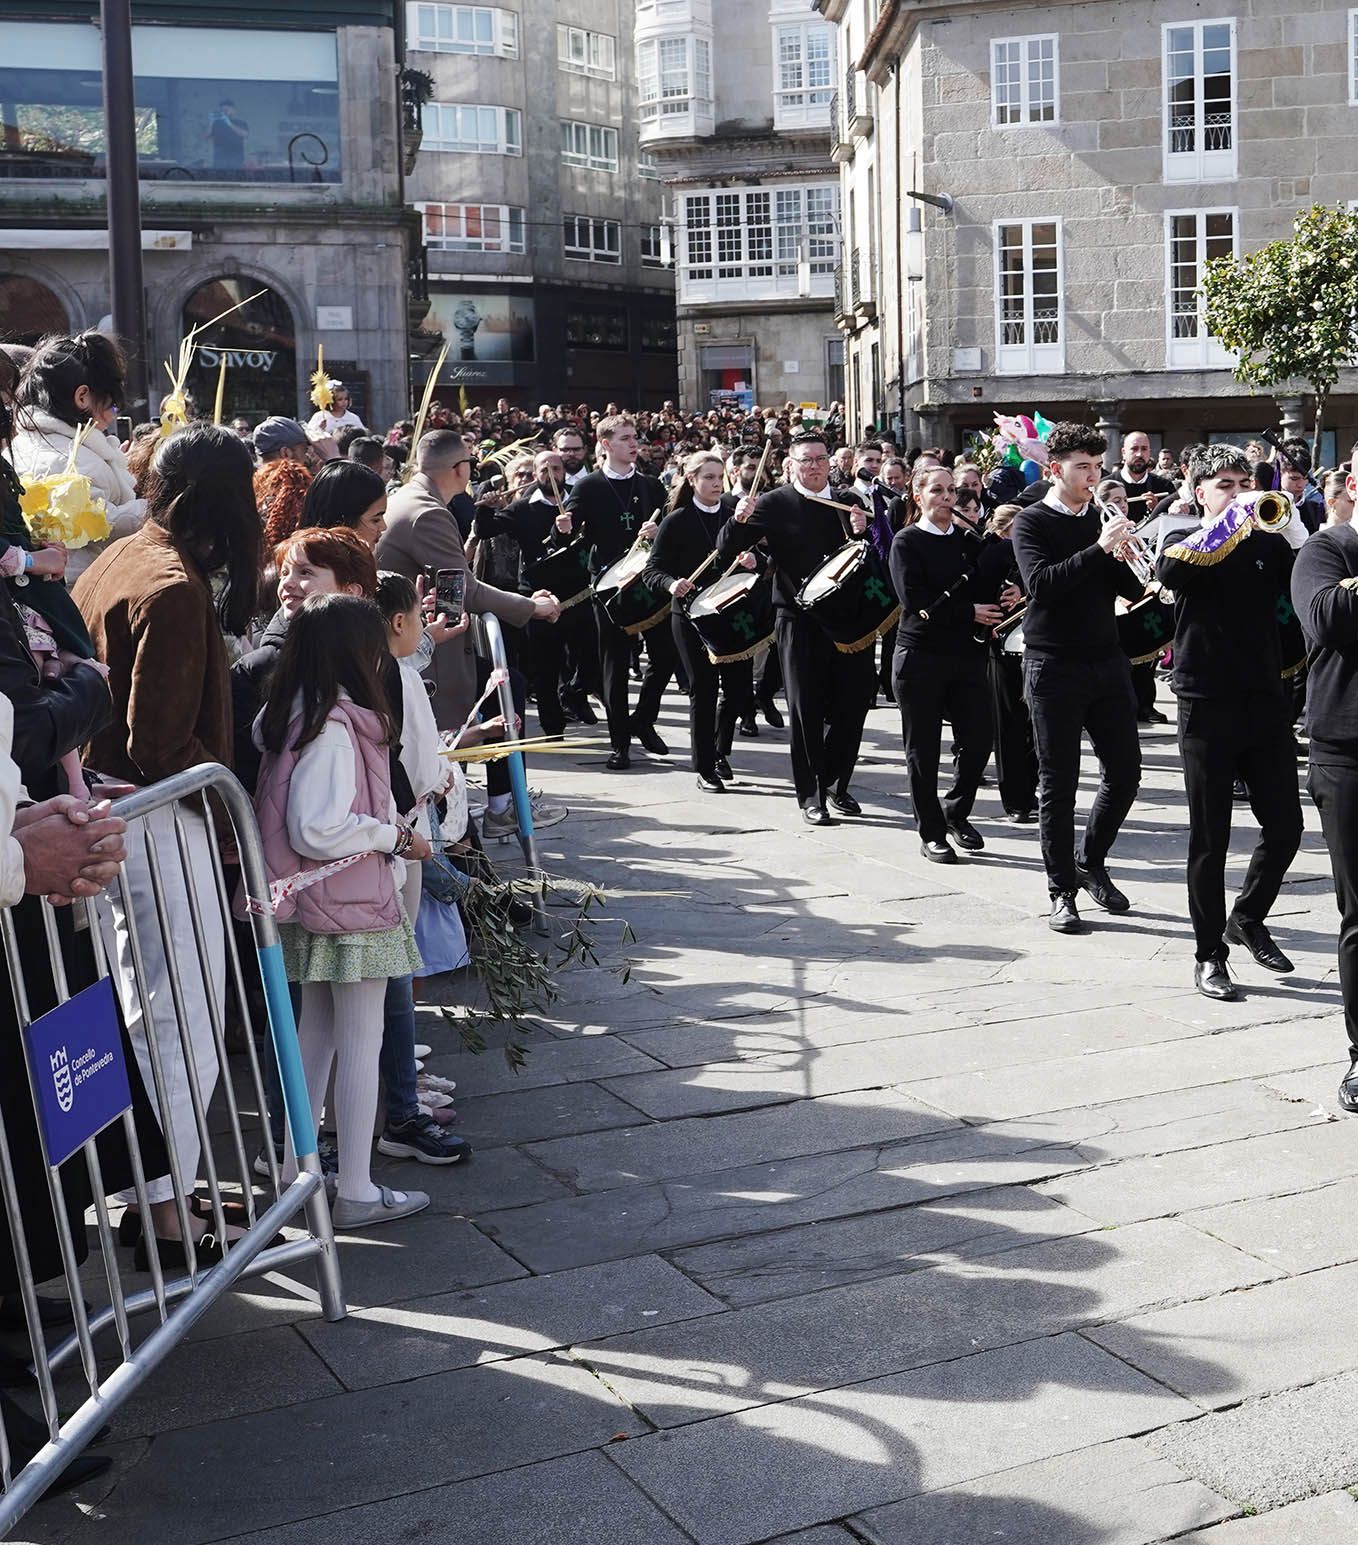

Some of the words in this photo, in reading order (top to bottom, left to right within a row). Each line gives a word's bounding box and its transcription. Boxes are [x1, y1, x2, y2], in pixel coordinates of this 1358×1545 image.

[200, 343, 278, 372] Savoy
[72, 1048, 96, 1071] Concello
[74, 1073, 82, 1086] de
[81, 1052, 114, 1081] Pontevedra
